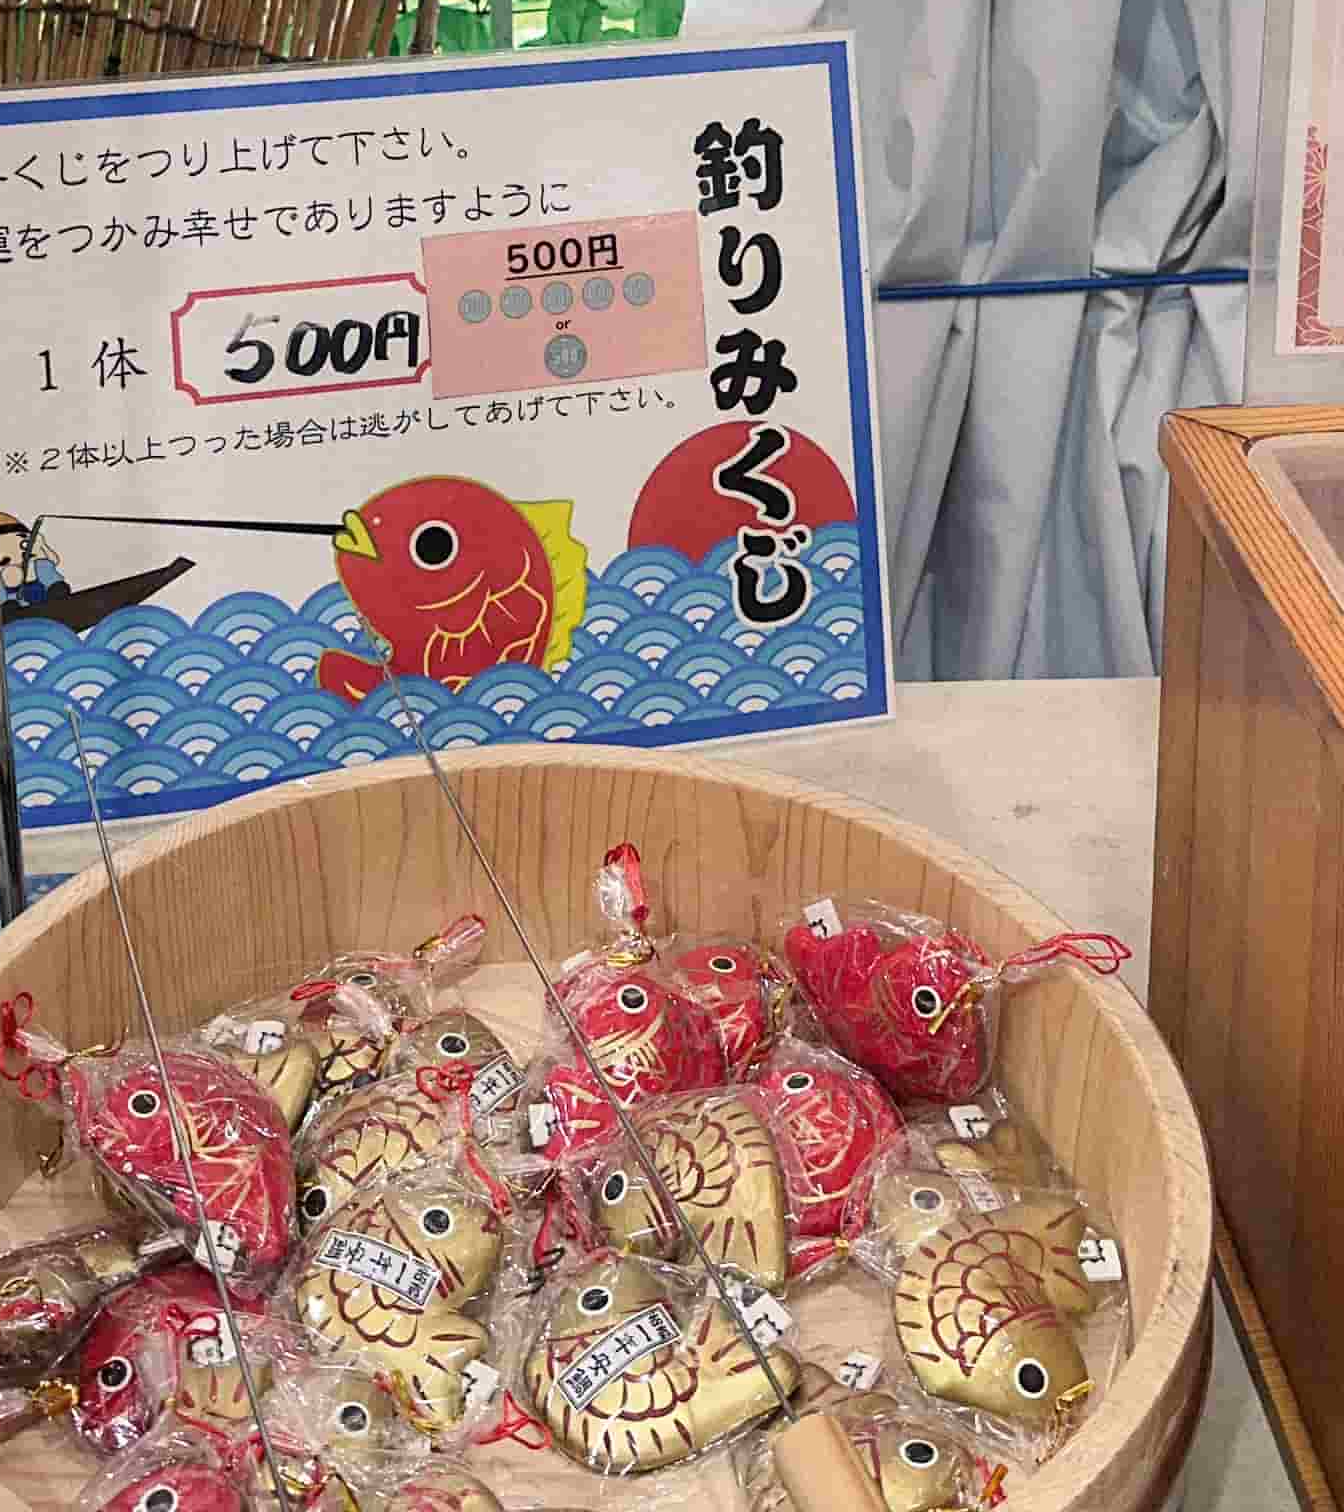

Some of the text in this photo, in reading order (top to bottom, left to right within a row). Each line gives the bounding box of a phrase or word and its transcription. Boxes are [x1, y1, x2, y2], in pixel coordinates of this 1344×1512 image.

[507, 233, 619, 274] 500円
[91, 337, 148, 389] 体
[224, 310, 420, 384] 500円
[555, 318, 571, 330] or
[693, 117, 808, 622] 釣りみくじ
